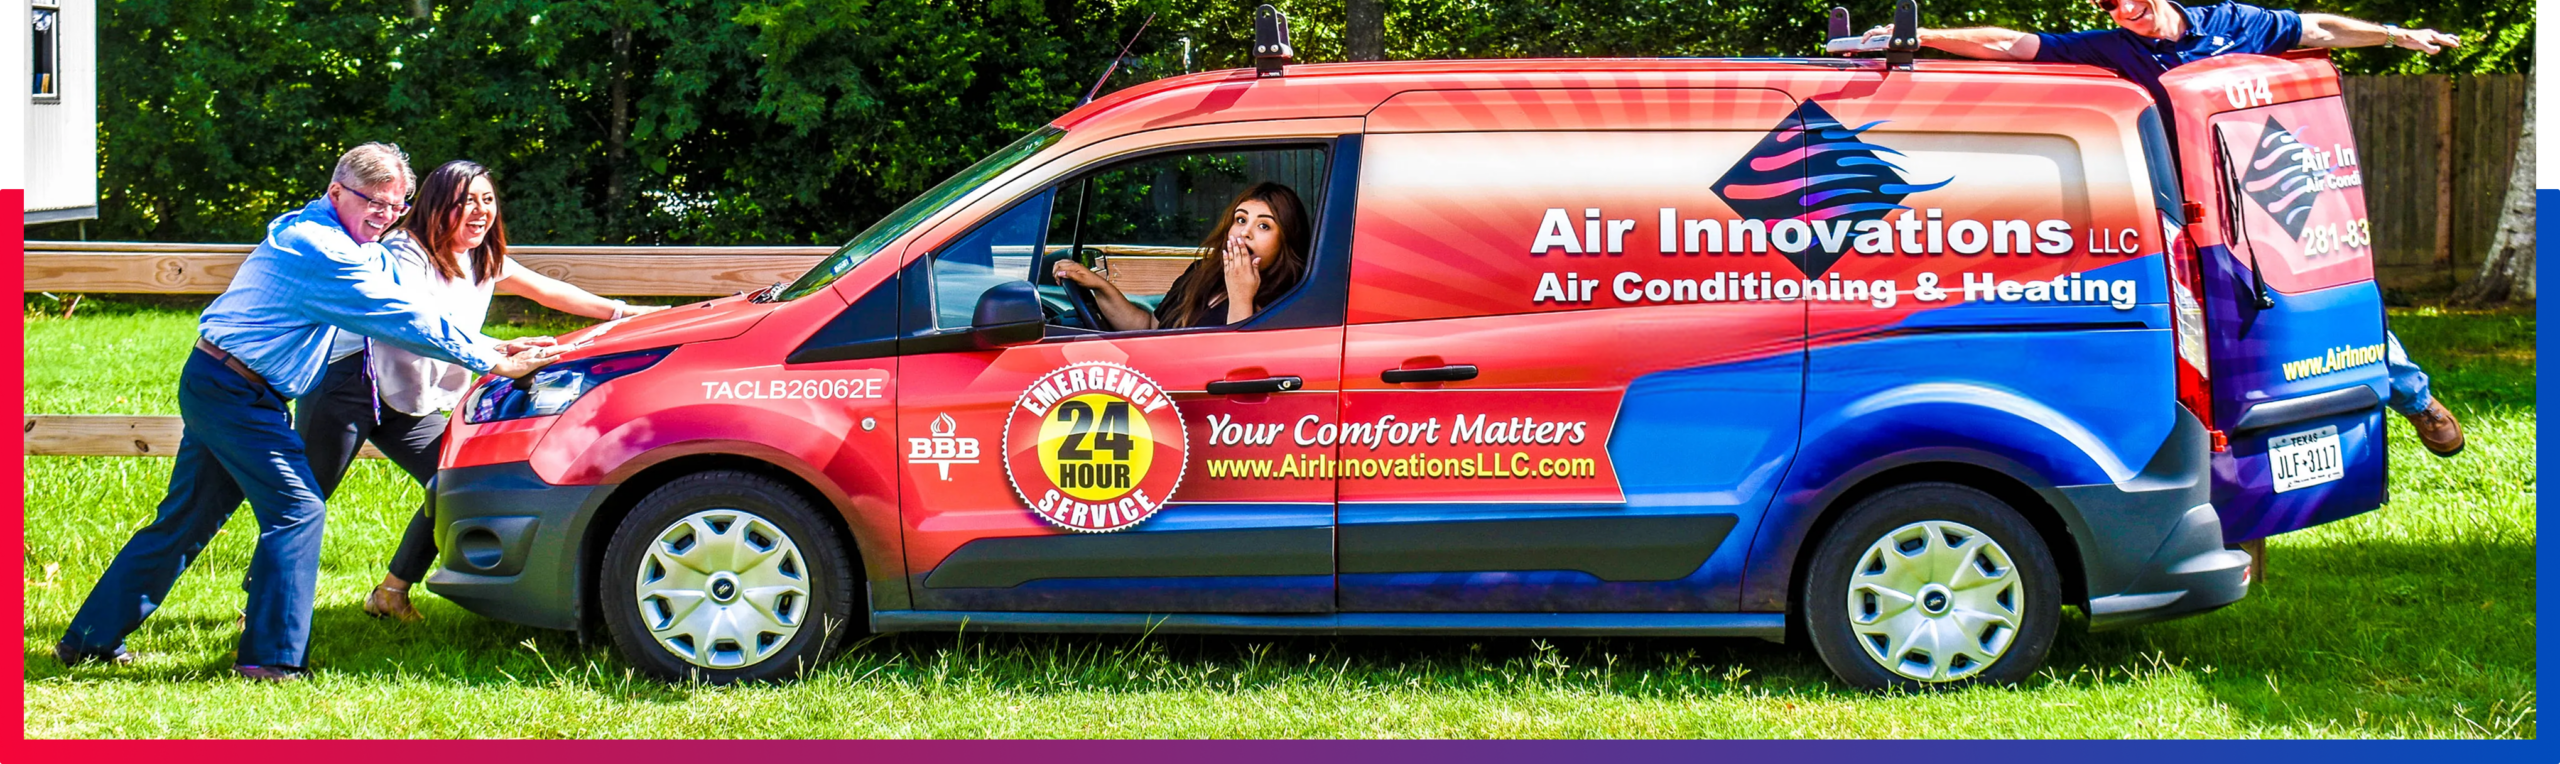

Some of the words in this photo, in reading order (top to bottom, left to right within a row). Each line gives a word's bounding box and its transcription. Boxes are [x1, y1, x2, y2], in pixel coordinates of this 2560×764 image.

[2225, 75, 2273, 109] 014
[2302, 146, 2331, 172] Air
[2305, 177, 2325, 193] Air
[1530, 207, 1636, 254] Air
[1659, 207, 2074, 254] Innovations
[2089, 228, 2139, 254] LLC
[1533, 272, 1599, 302] Air
[1612, 271, 1897, 309] Conditioning
[1913, 271, 1948, 302] &
[1963, 271, 2136, 310] Heating
[701, 378, 883, 400] TACLB26062E
[1021, 366, 1169, 418] EMERGENCY
[1057, 400, 1134, 461] 24
[1206, 413, 1285, 447] Your
[1293, 413, 1440, 450] Comfort
[1449, 414, 1587, 446] Matters
[2290, 432, 2318, 447] TEXAS
[908, 437, 980, 459] BBB
[1060, 463, 1130, 489] HOUR
[1207, 451, 1596, 478] www.AirInnovationsLLC.com
[1037, 488, 1156, 528] SERVICE
